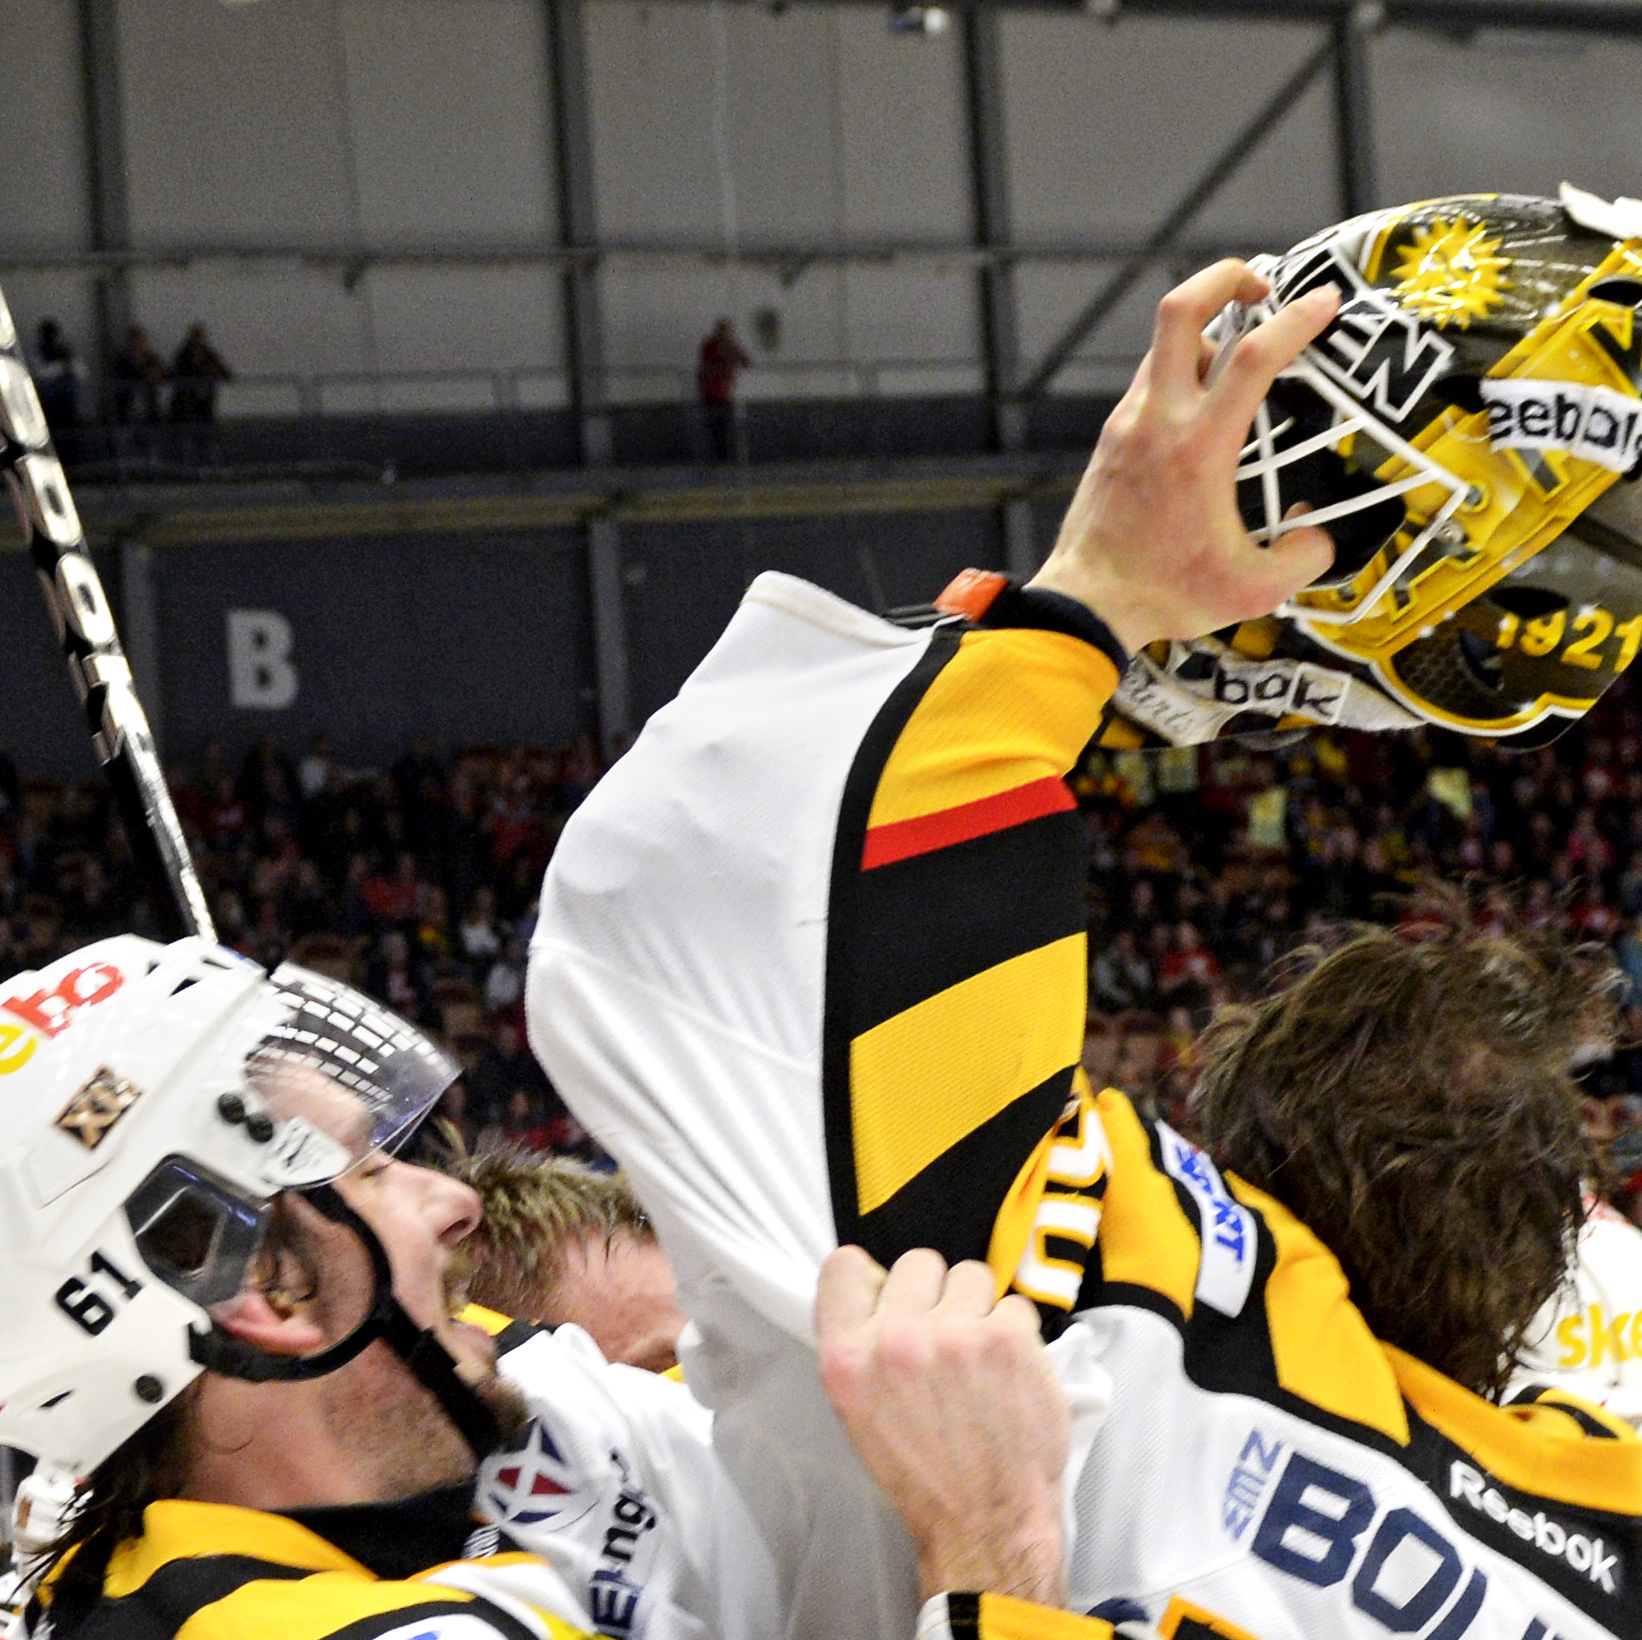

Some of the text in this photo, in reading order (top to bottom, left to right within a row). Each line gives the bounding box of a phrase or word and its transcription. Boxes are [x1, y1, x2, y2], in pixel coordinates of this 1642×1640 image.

[225, 608, 300, 709] B
[54, 1250, 144, 1337] 61
[1449, 1460, 1621, 1594] Reebok
